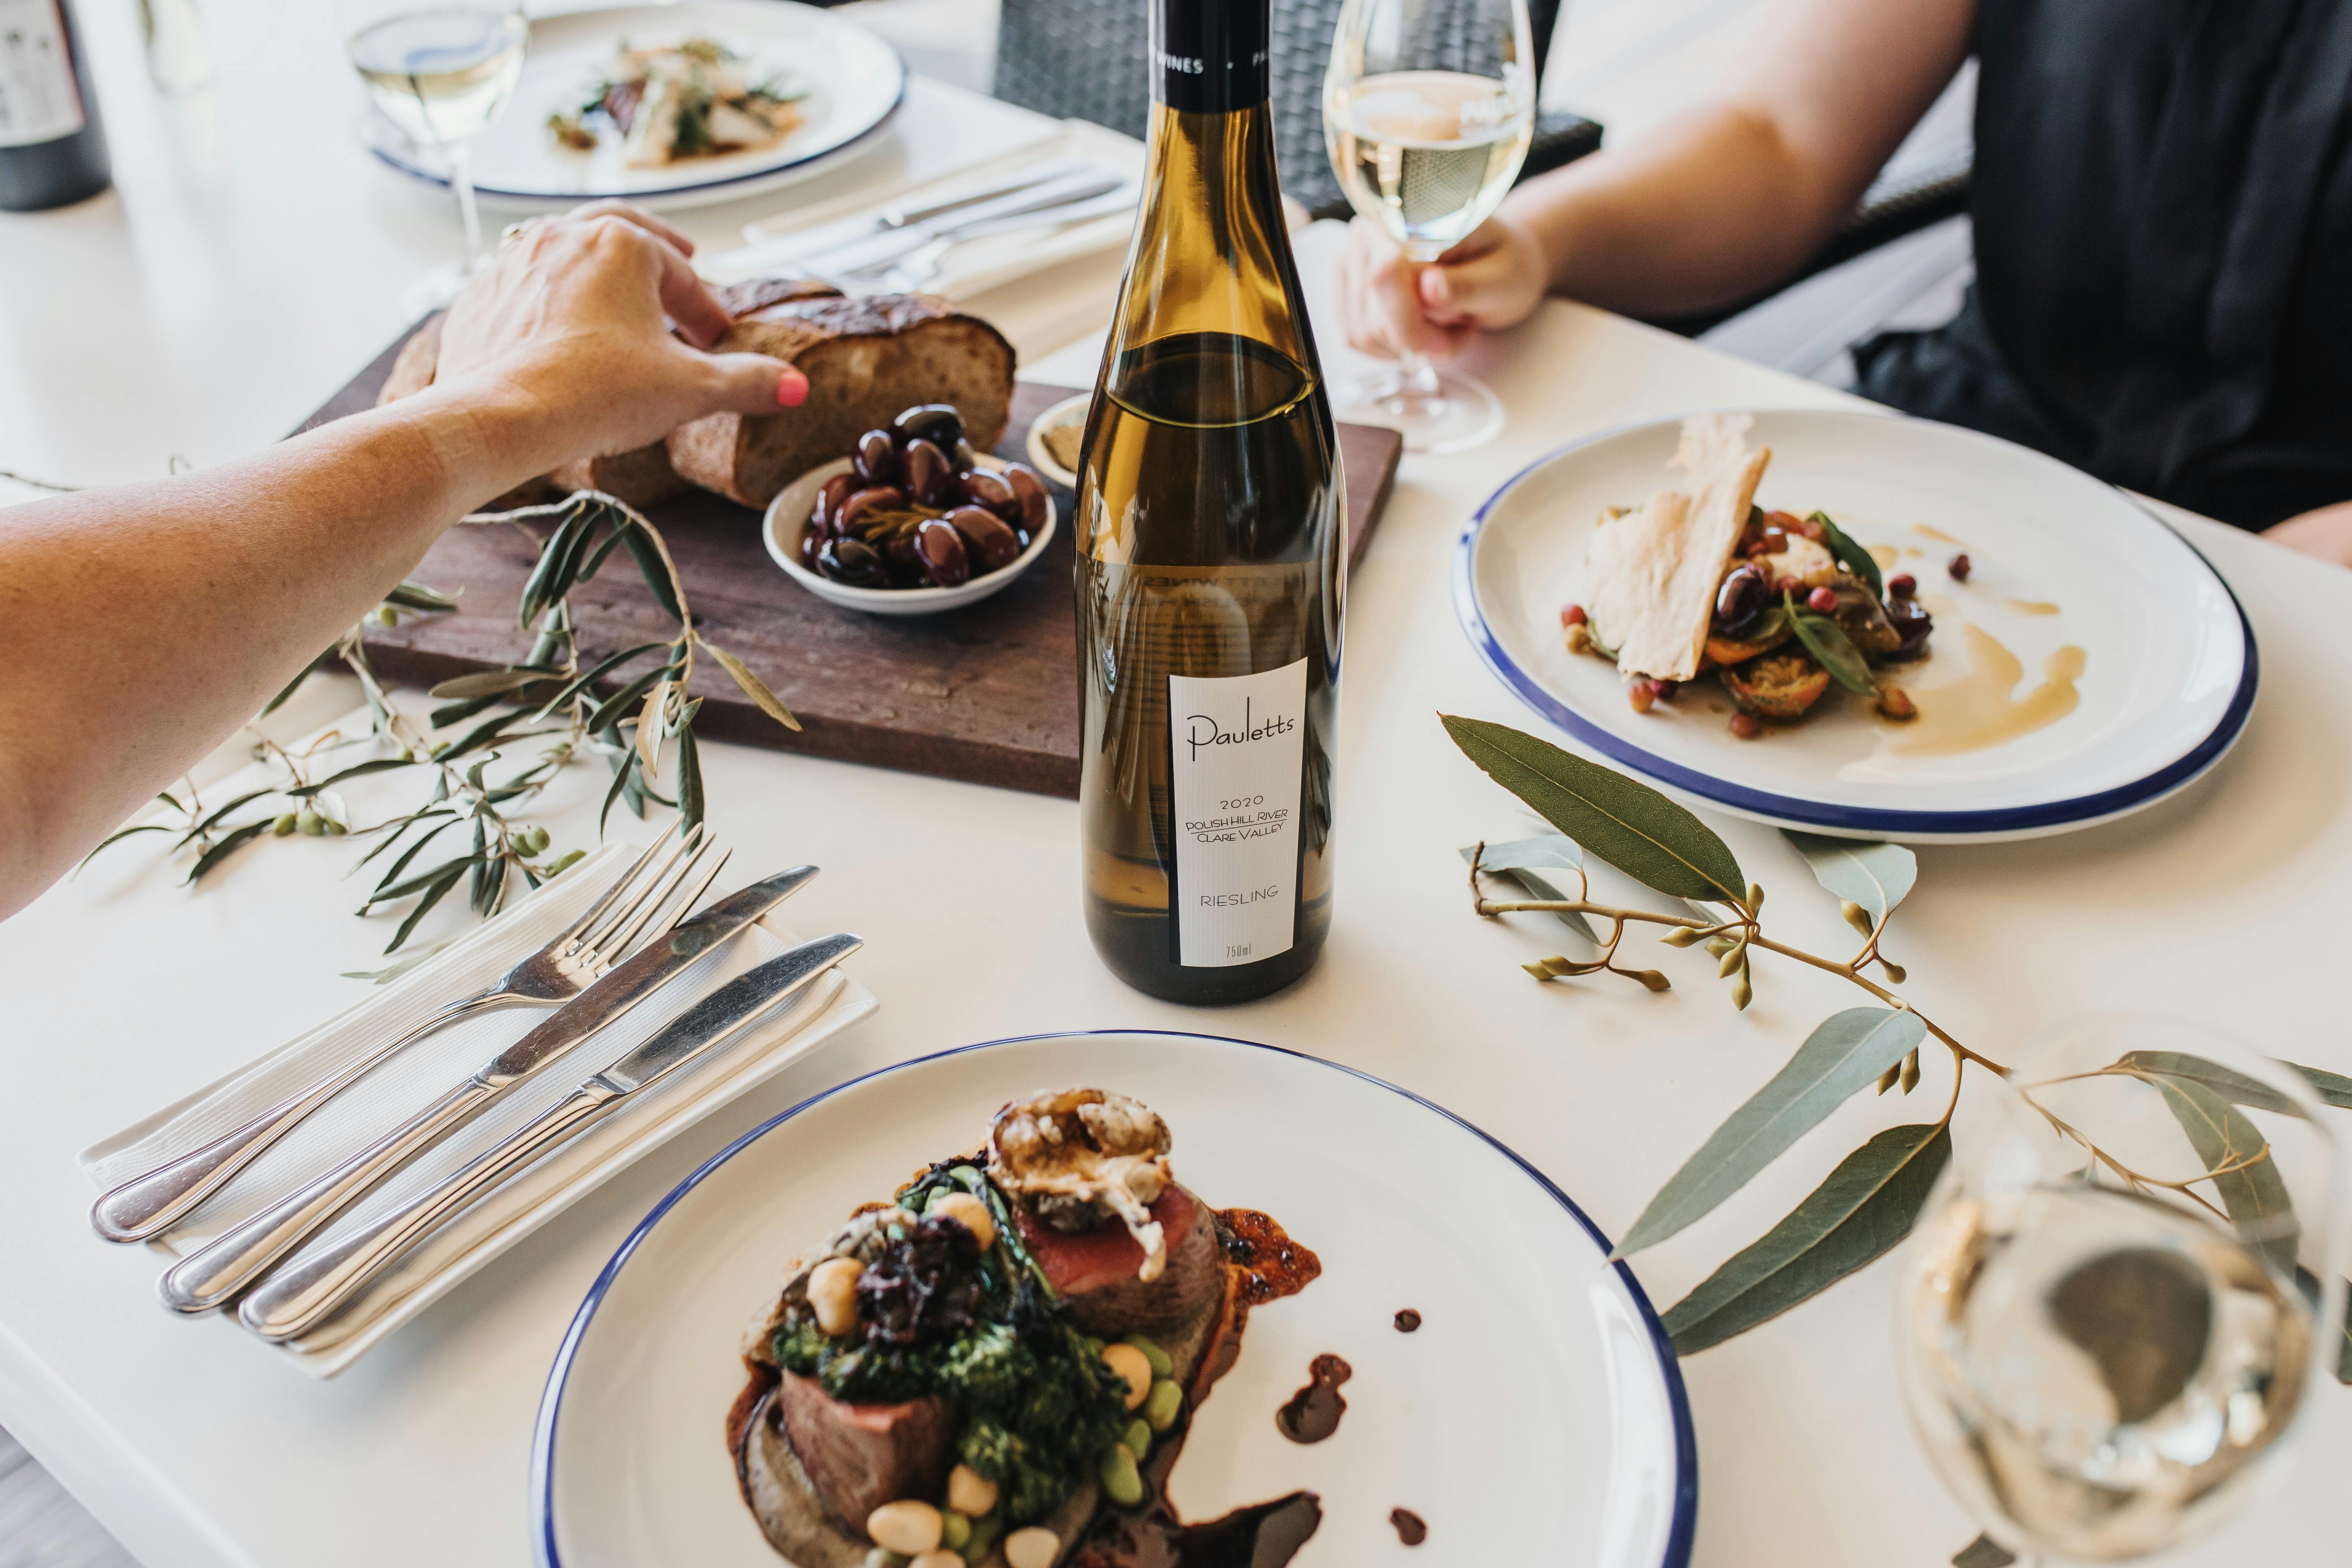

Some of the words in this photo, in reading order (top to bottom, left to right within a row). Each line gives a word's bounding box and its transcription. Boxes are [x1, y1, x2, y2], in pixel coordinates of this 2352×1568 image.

[1186, 696, 1294, 762] Pauletts
[1220, 795, 1263, 810] 2020
[1185, 818, 1228, 832] POLISH
[1231, 814, 1255, 826] HILL
[1257, 809, 1288, 822] RIVER
[1197, 833, 1237, 842] CLARE
[1238, 821, 1284, 840] VALLEY
[1201, 885, 1278, 907] RIESLING
[1226, 943, 1251, 958] 750ml
